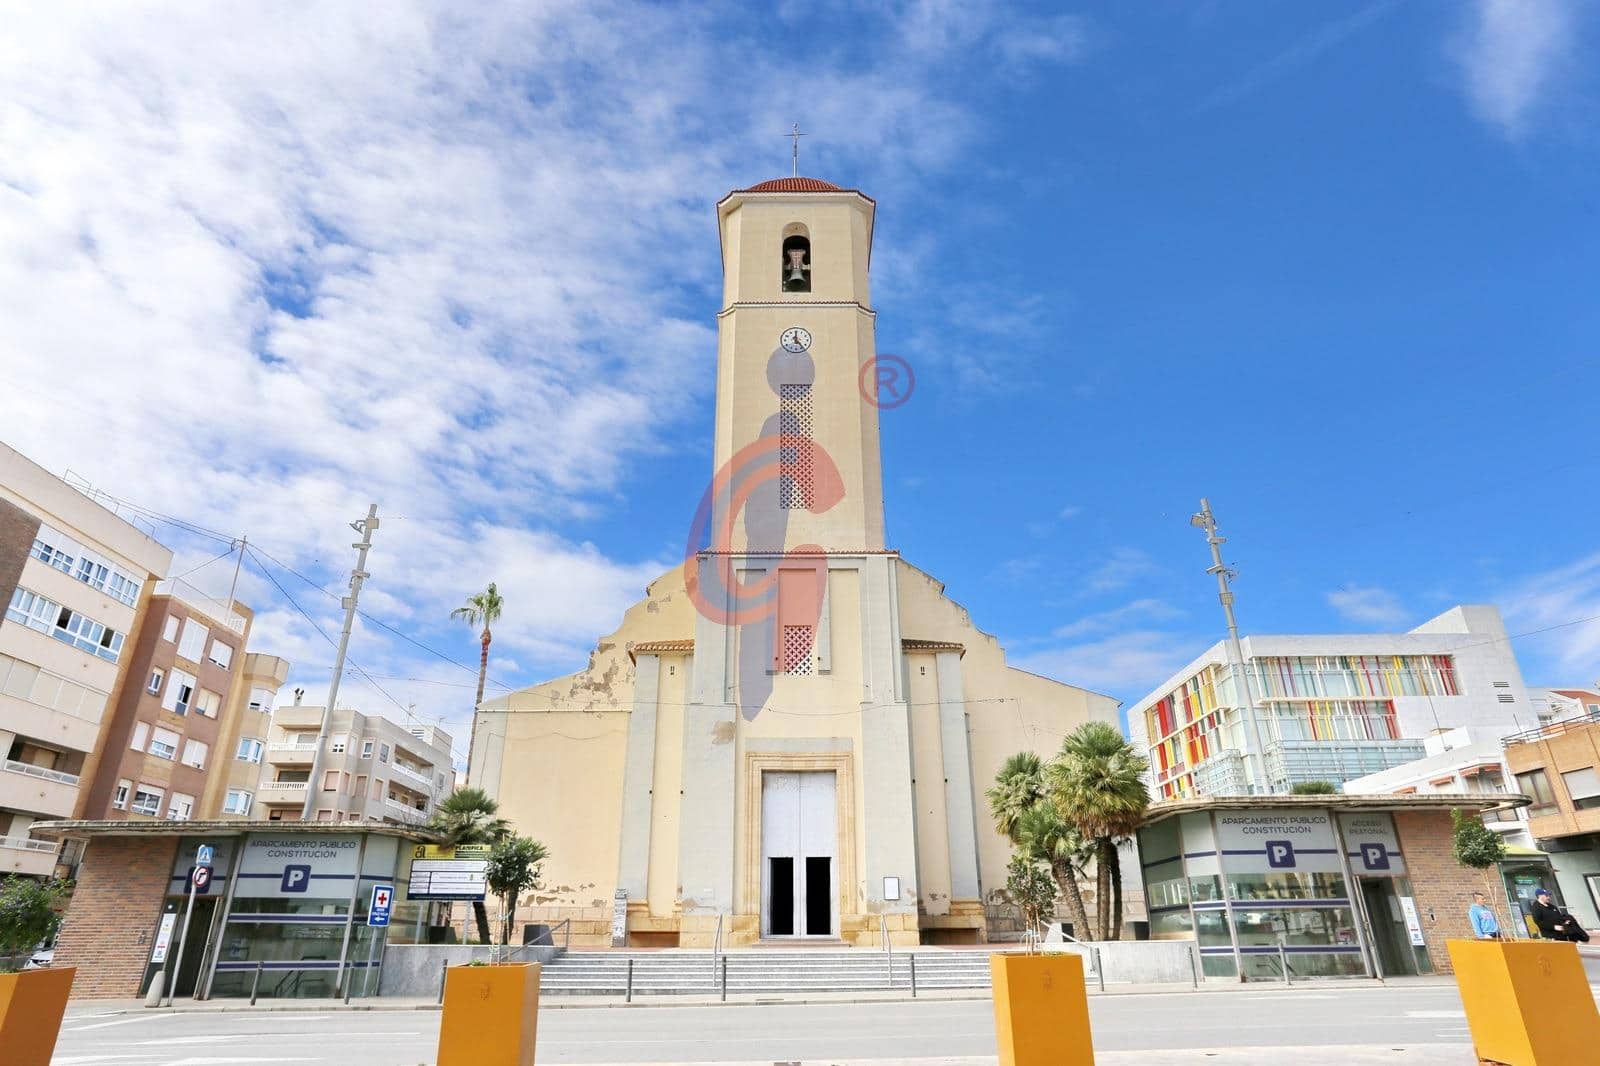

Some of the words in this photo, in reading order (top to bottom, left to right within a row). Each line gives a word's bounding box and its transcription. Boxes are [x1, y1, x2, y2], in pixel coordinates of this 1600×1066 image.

[1222, 816, 1287, 825] APARCAMIENTO
[1290, 815, 1327, 824] PÚBLICO
[1242, 825, 1312, 834] CONSTITUCIÓN
[250, 840, 316, 849] APARCAMIENTO
[319, 839, 357, 849] PÚBLICO
[267, 849, 338, 858] CONSTITUCIÓN
[1272, 845, 1288, 863] P
[1367, 848, 1381, 865] P
[287, 869, 305, 888] P
